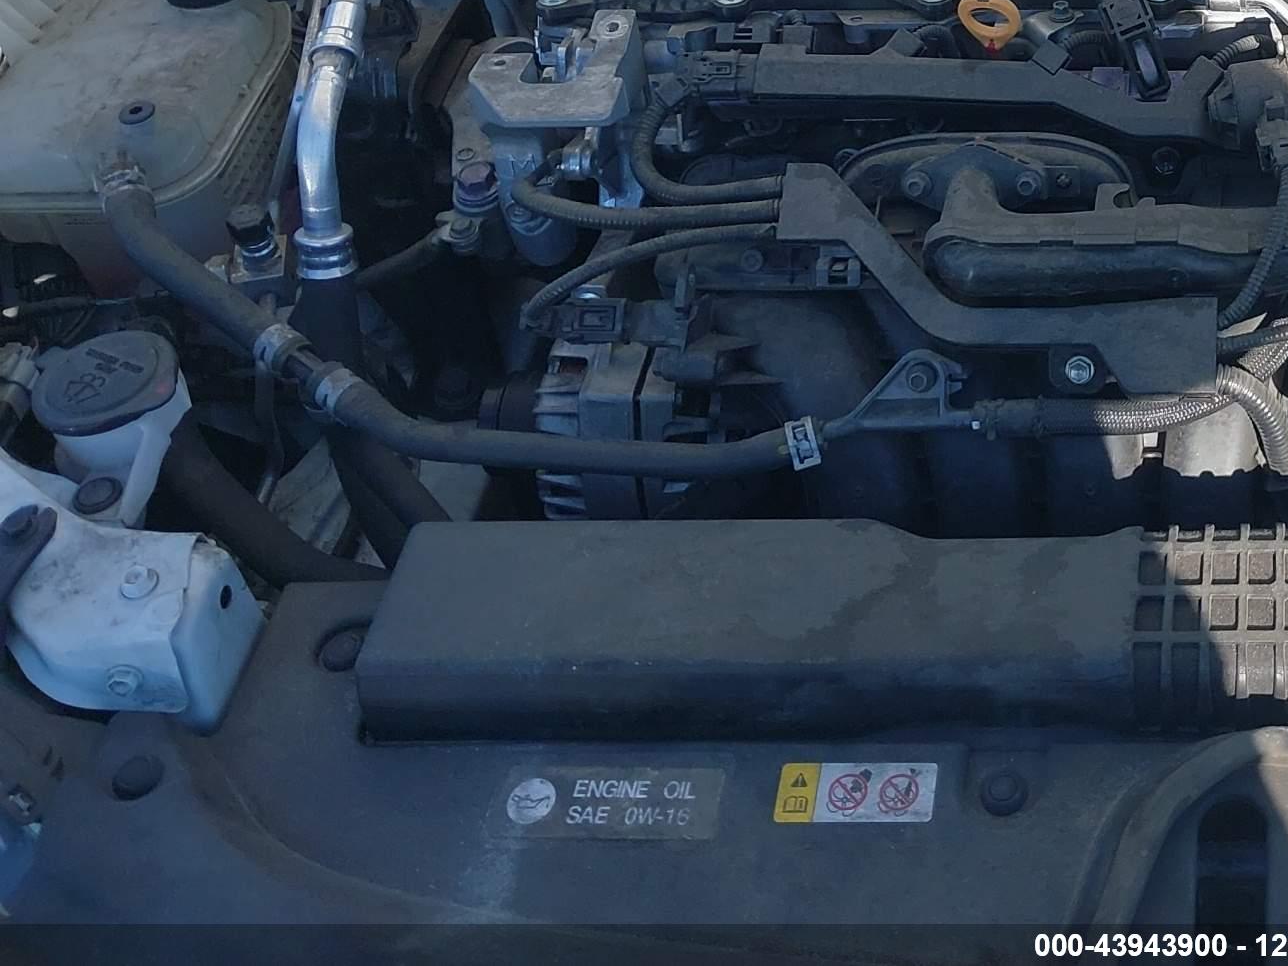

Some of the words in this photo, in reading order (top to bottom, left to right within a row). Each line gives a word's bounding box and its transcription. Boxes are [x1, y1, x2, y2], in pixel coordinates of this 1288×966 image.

[572, 780, 651, 799] ENGINE
[662, 780, 697, 800] OIL
[565, 805, 611, 825] SAE
